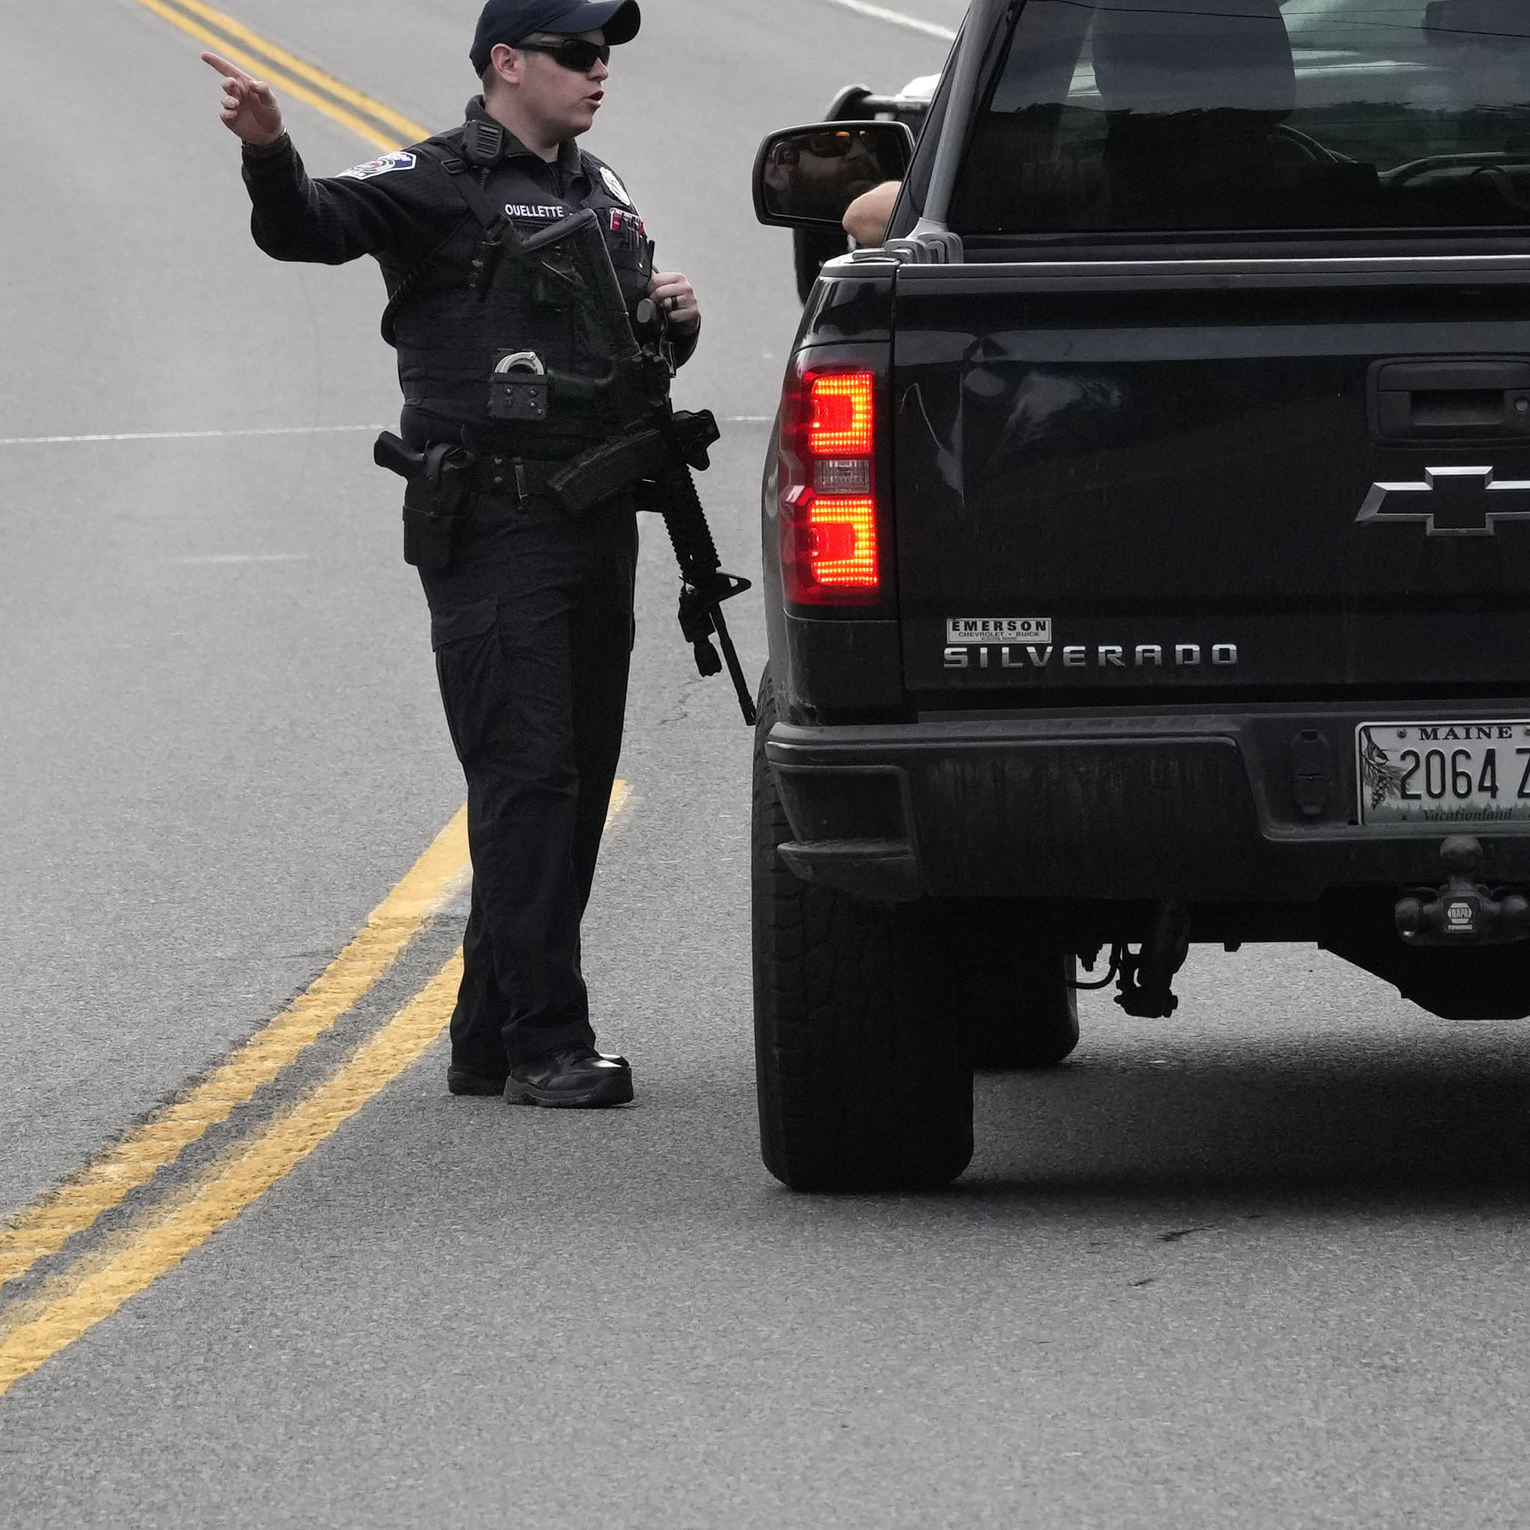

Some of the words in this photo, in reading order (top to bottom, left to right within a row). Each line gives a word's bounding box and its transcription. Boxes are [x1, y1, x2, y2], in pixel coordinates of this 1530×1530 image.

[504, 203, 565, 218] OUELLETTE
[951, 620, 1047, 632] EMERSON
[943, 644, 1238, 668] SILVERADO
[1419, 726, 1513, 741] MAINE
[1400, 748, 1499, 800] 2064
[1423, 807, 1513, 822] Vacationland
